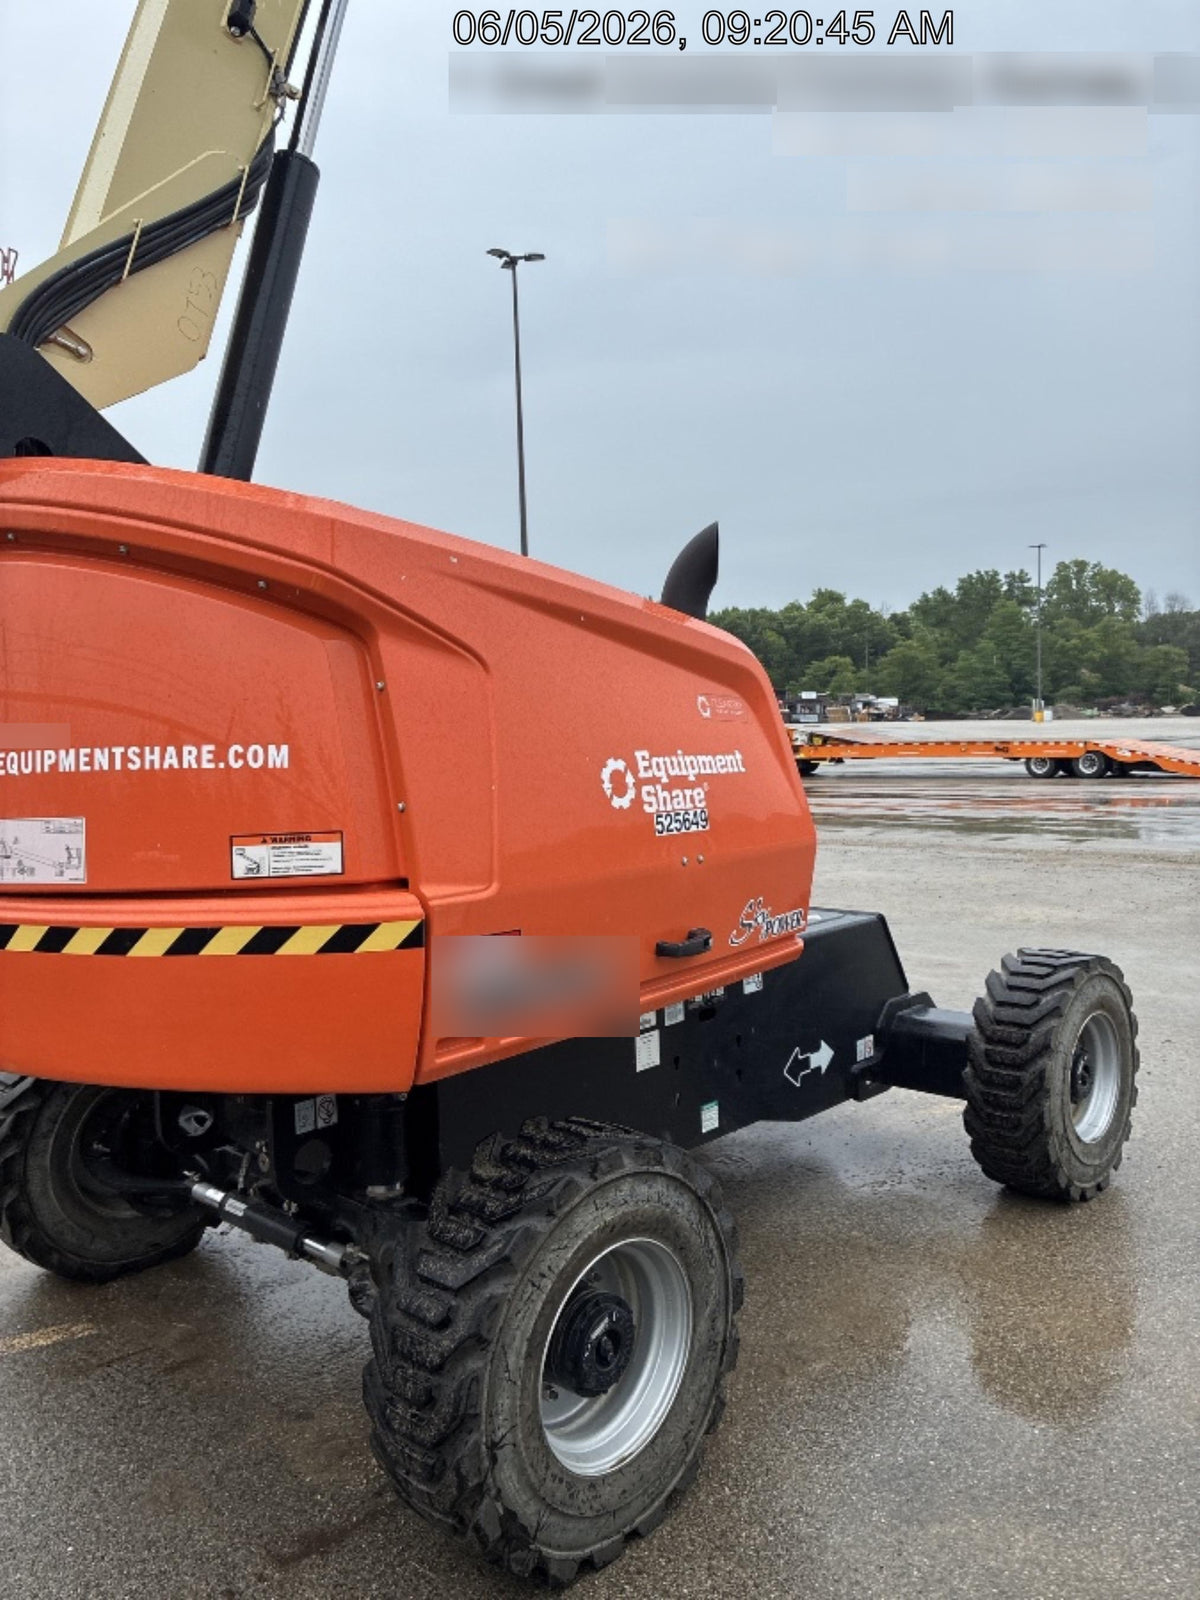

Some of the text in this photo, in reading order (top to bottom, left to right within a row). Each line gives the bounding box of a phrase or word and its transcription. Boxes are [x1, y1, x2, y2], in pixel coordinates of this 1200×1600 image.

[0, 745, 289, 775] EQUIPMENTSHARE.COM
[634, 749, 746, 783] Equipment
[641, 784, 706, 813] Share
[655, 810, 709, 834] 525649
